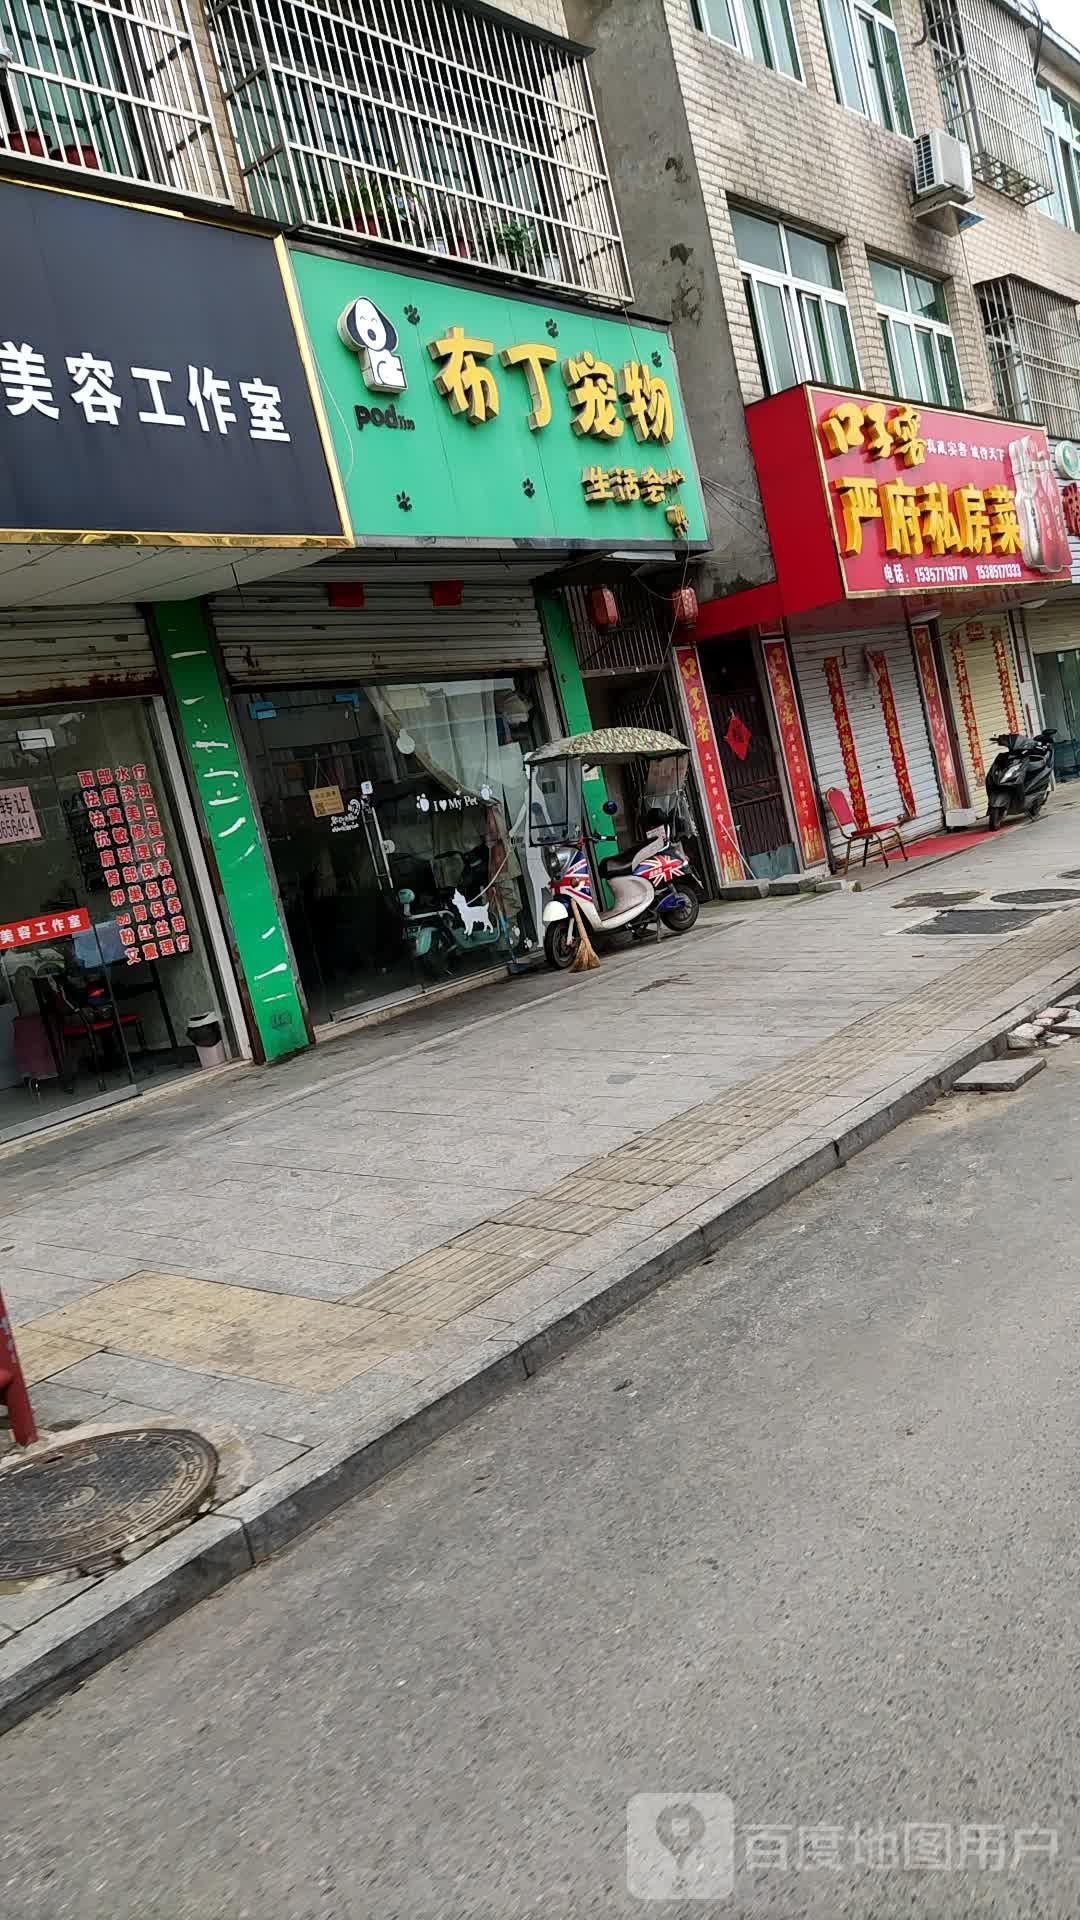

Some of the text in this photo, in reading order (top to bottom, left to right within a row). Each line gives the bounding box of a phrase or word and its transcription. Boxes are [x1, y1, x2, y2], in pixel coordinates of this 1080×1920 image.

[0, 341, 291, 442] 美容工作室
[427, 326, 675, 446] 布丁宠物
[834, 476, 1023, 556] 严府私房菜
[914, 565, 968, 582] 15357719770
[976, 563, 1022, 579] 15385171333
[78, 764, 146, 788] 面部水疗
[84, 783, 153, 808] 祛痘淡斑
[448, 797, 462, 811] My
[463, 795, 479, 807] Pet
[94, 821, 163, 848] 抗敏修复
[100, 841, 166, 867] 肩颈理疗
[104, 859, 172, 887] 肾部保养
[110, 878, 177, 907] 卵巢保养
[0, 914, 82, 944] 美容工作室
[119, 915, 186, 946] 粉红丝带
